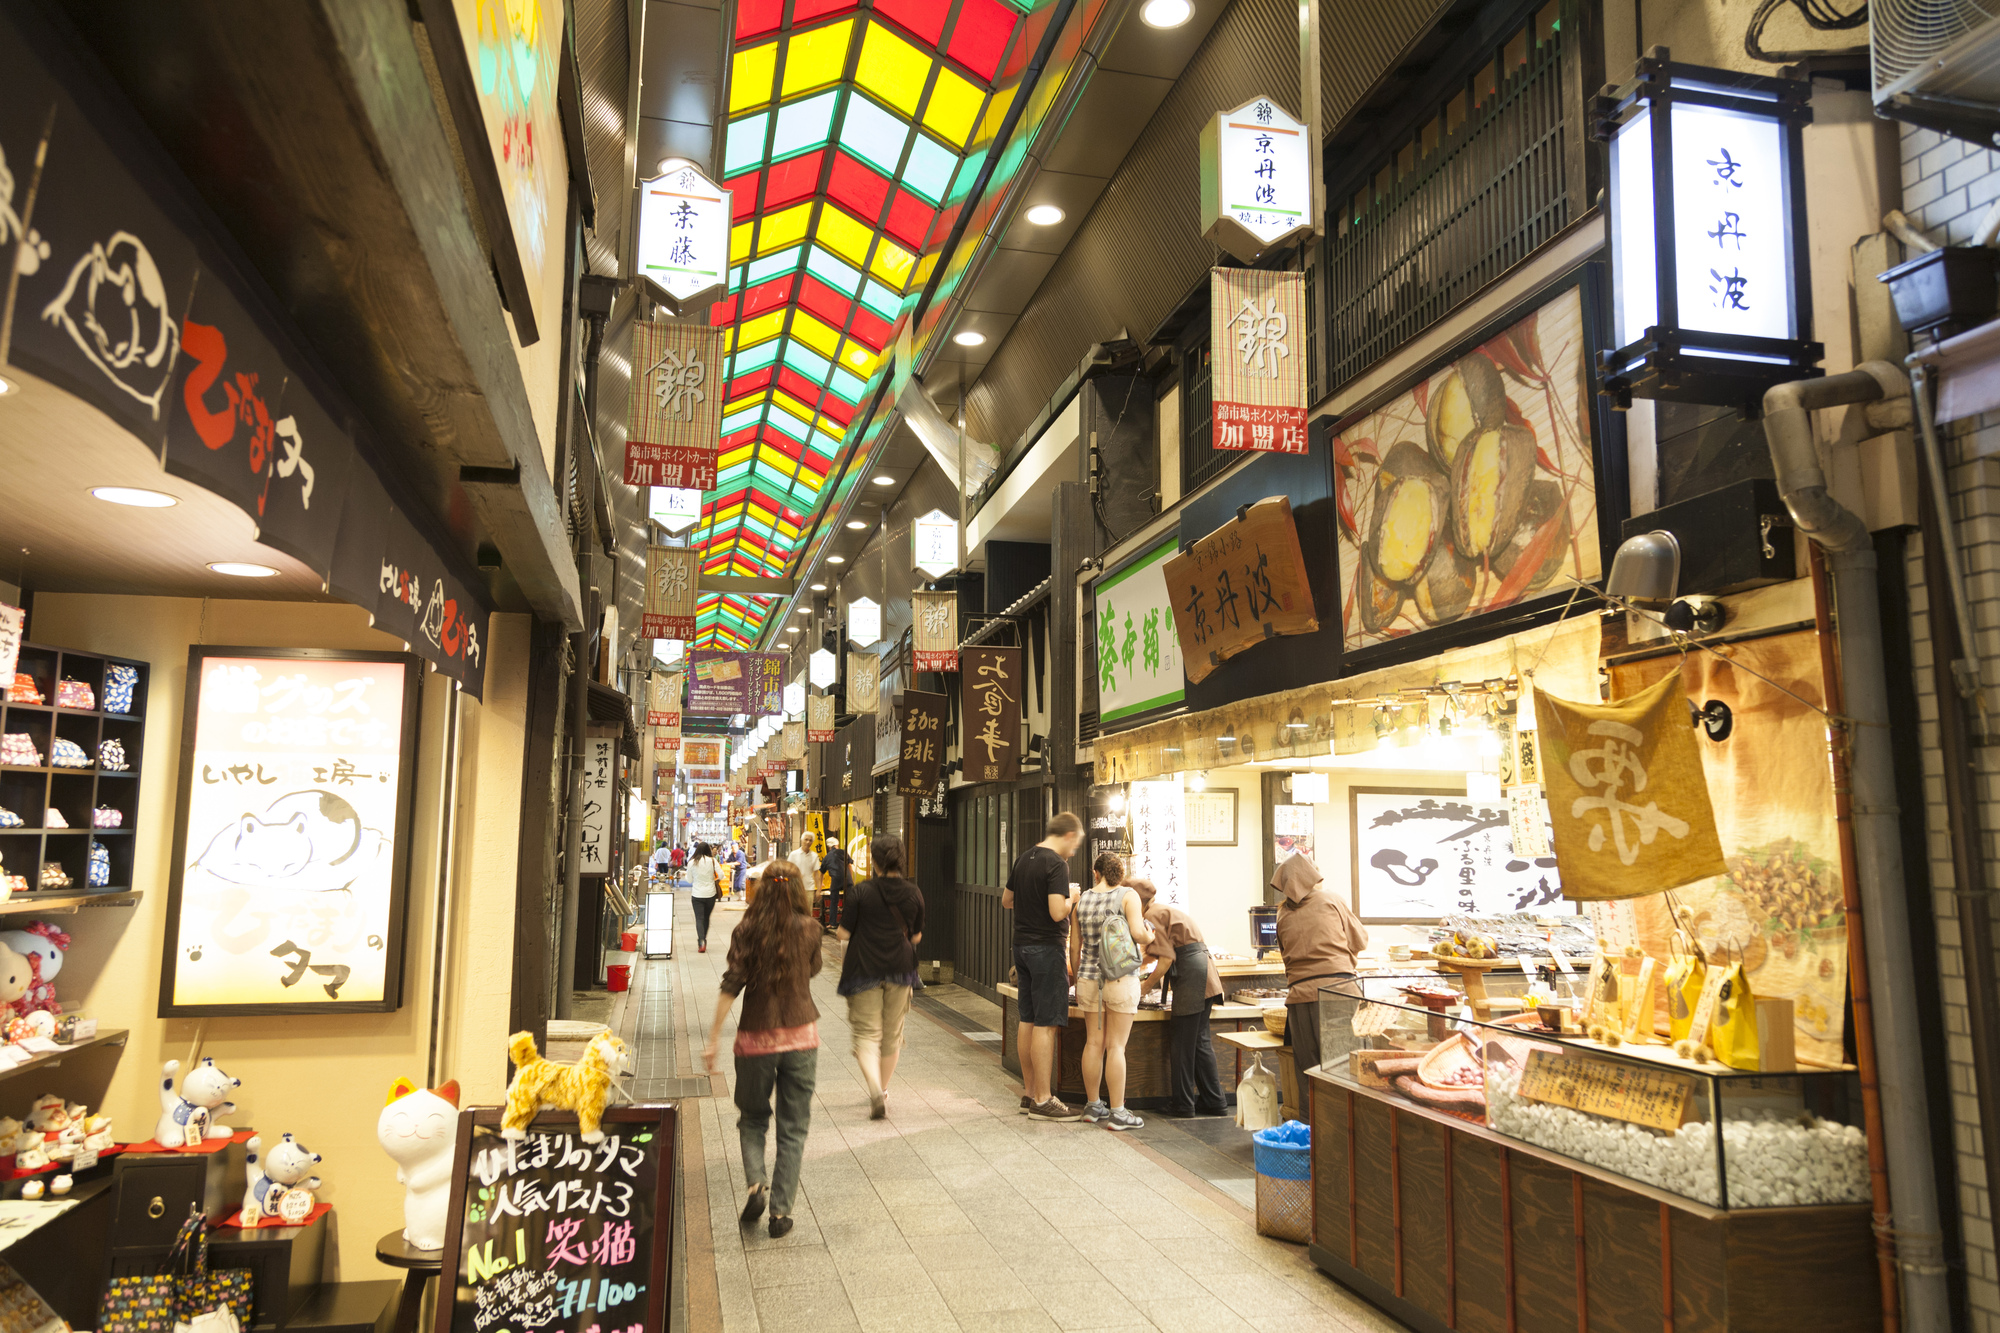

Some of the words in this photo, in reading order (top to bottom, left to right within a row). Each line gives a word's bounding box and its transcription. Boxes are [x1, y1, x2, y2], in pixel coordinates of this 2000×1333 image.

[1253, 102, 1273, 125] 錦
[1254, 133, 1277, 205] 京丹波
[1706, 147, 1751, 311] 京丹波
[1226, 296, 1289, 379] 錦
[644, 347, 706, 422] 錦
[1239, 367, 1273, 379] NISHIKI
[1217, 404, 1305, 426] 錦市場ポイントカード
[629, 444, 715, 465] 錦市場ポイントカード
[1217, 421, 1305, 453] 加盟店
[627, 460, 715, 490] 加盟店
[652, 557, 689, 603] 錦
[1184, 542, 1284, 646] 京丹波
[643, 625, 695, 641] 加盟店
[645, 614, 695, 626] 錦市場ポイントカード
[919, 600, 949, 640] 錦
[754, 657, 763, 713] ポイントカード
[763, 658, 781, 713] 錦市場
[851, 668, 874, 698] 錦
[915, 659, 957, 672] 加盟店
[655, 678, 677, 705] 錦
[813, 701, 831, 724] 錦
[903, 707, 939, 764] 珈琲
[1453, 839, 1481, 913] ふる里の味
[367, 934, 384, 951] の
[269, 939, 351, 1000] タマ
[489, 1178, 635, 1226] 人気ベスト3
[468, 1227, 526, 1286] No.1
[544, 1216, 636, 1272] 笑い猫
